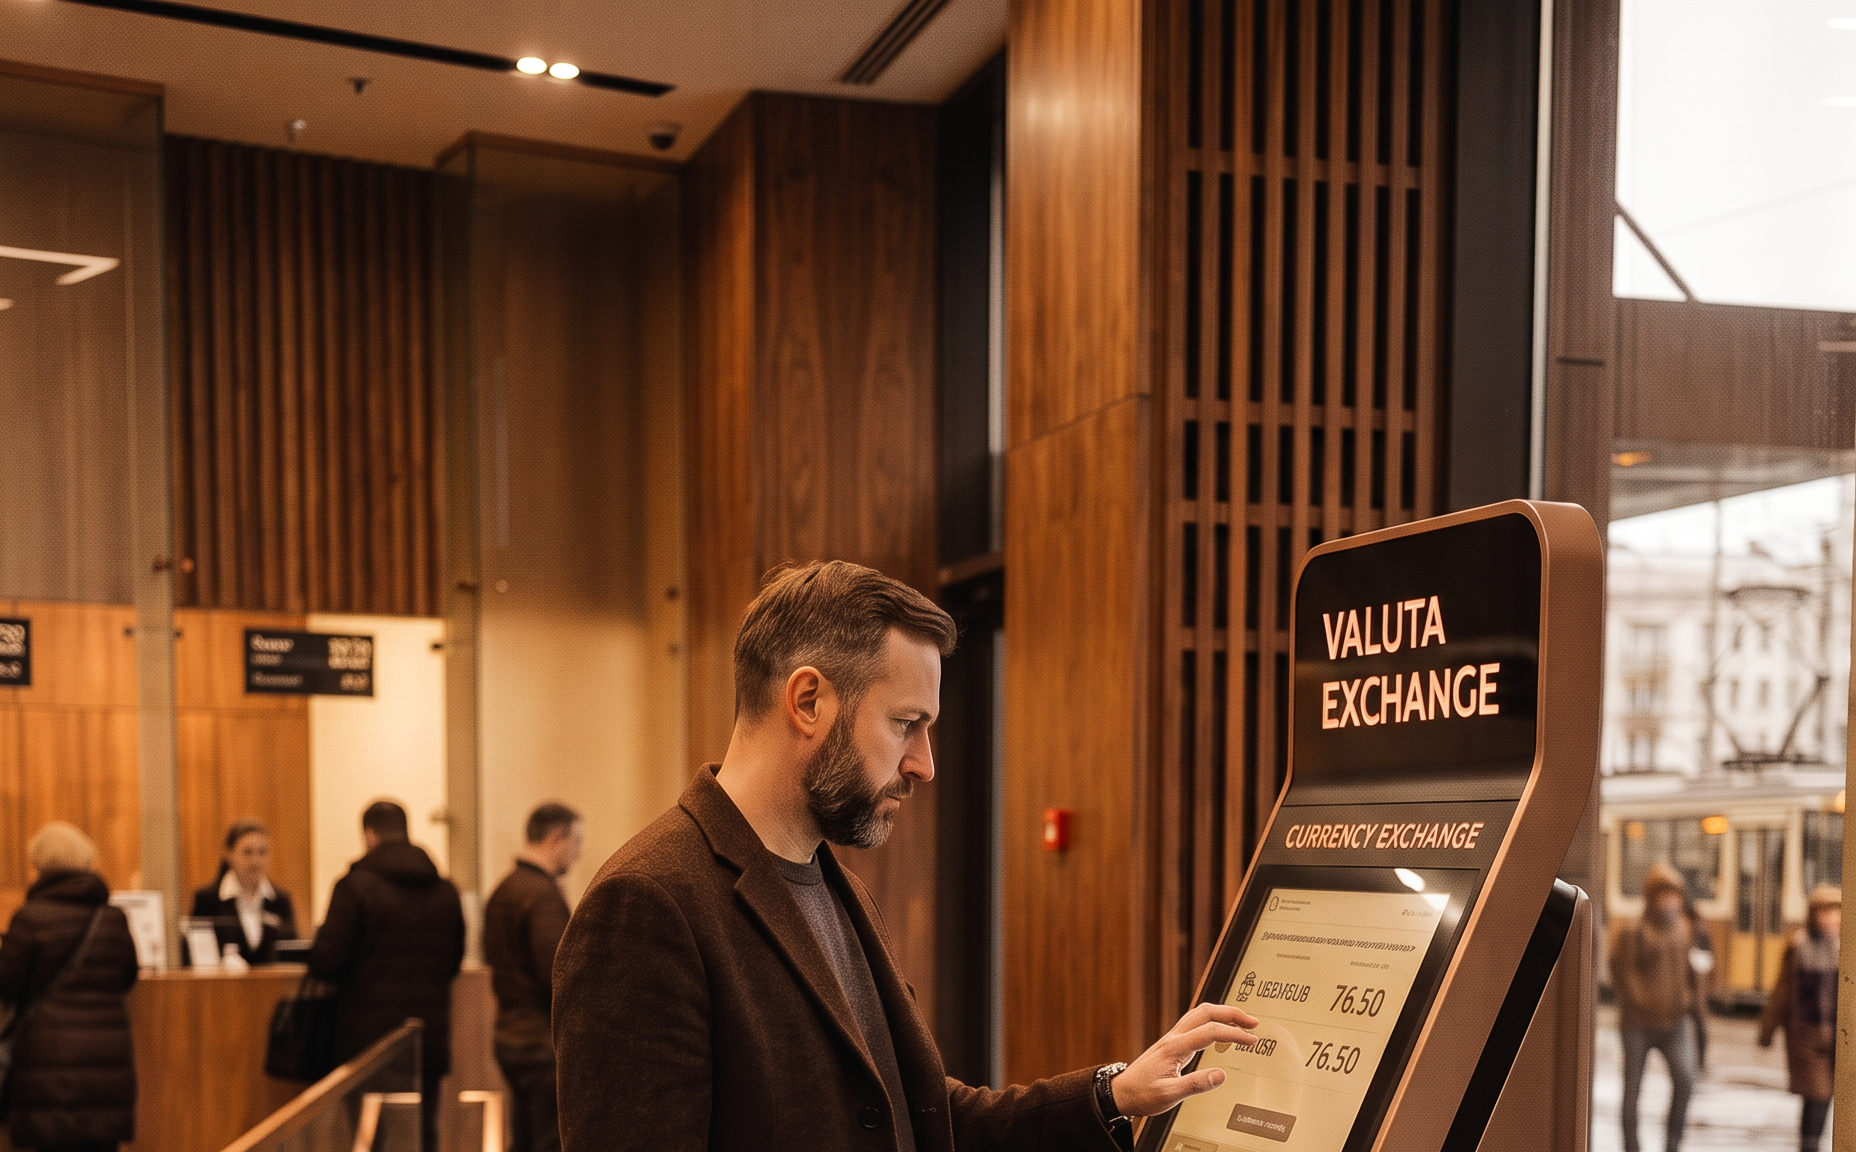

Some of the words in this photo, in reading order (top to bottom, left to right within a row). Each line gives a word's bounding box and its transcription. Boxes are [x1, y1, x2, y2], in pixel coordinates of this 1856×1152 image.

[1322, 595, 1447, 660] VALUTA
[1321, 662, 1501, 730] EXCHANGE
[1285, 823, 1379, 849] CURRENCY
[1375, 822, 1485, 849] EXCHANGE
[1329, 984, 1386, 1018] 76.50
[1305, 1040, 1361, 1075] 76.50
